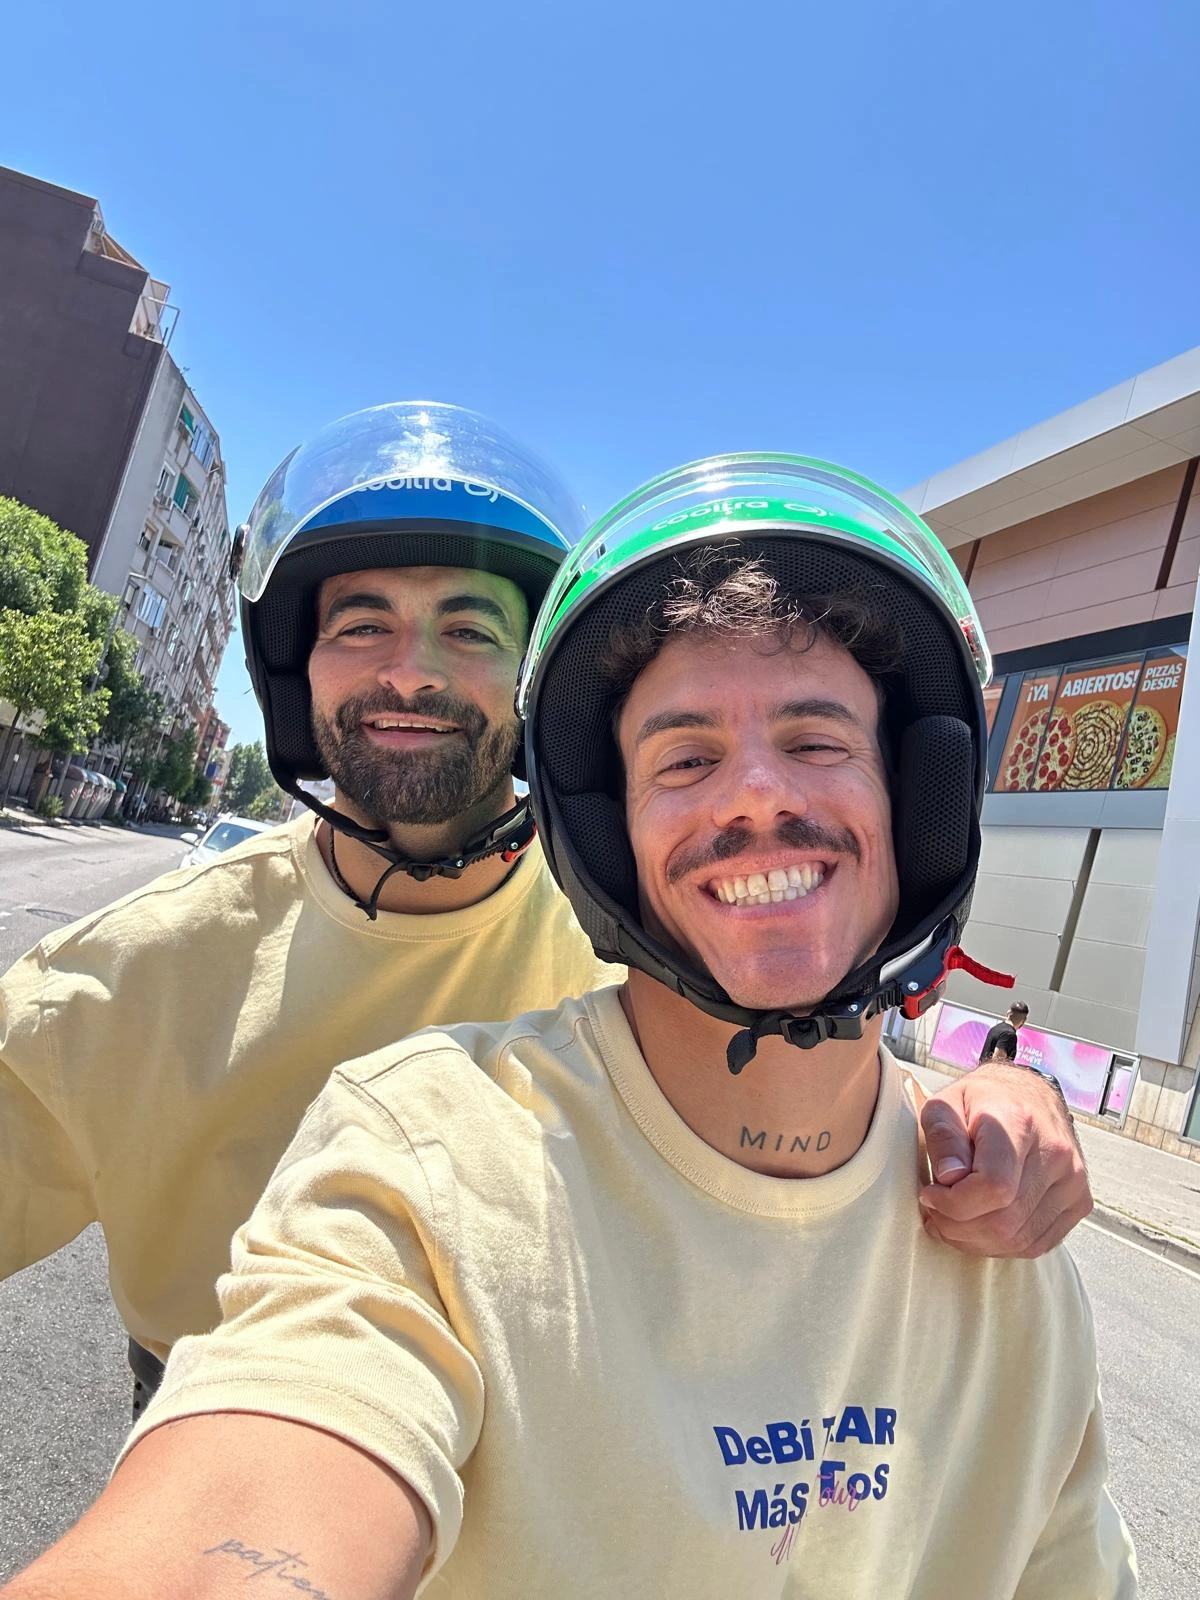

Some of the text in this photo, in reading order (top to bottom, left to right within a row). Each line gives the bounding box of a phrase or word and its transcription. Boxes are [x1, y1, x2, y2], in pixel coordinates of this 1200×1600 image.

[651, 501, 769, 532] cooltra
[1142, 675, 1179, 693] DESDE
[1145, 663, 1183, 679] PIZZAS
[1026, 671, 1139, 703] ¡YA ABIERTOS!
[740, 1126, 831, 1153] MIND
[713, 1420, 815, 1466] DeBí
[735, 1483, 810, 1531] MáS
